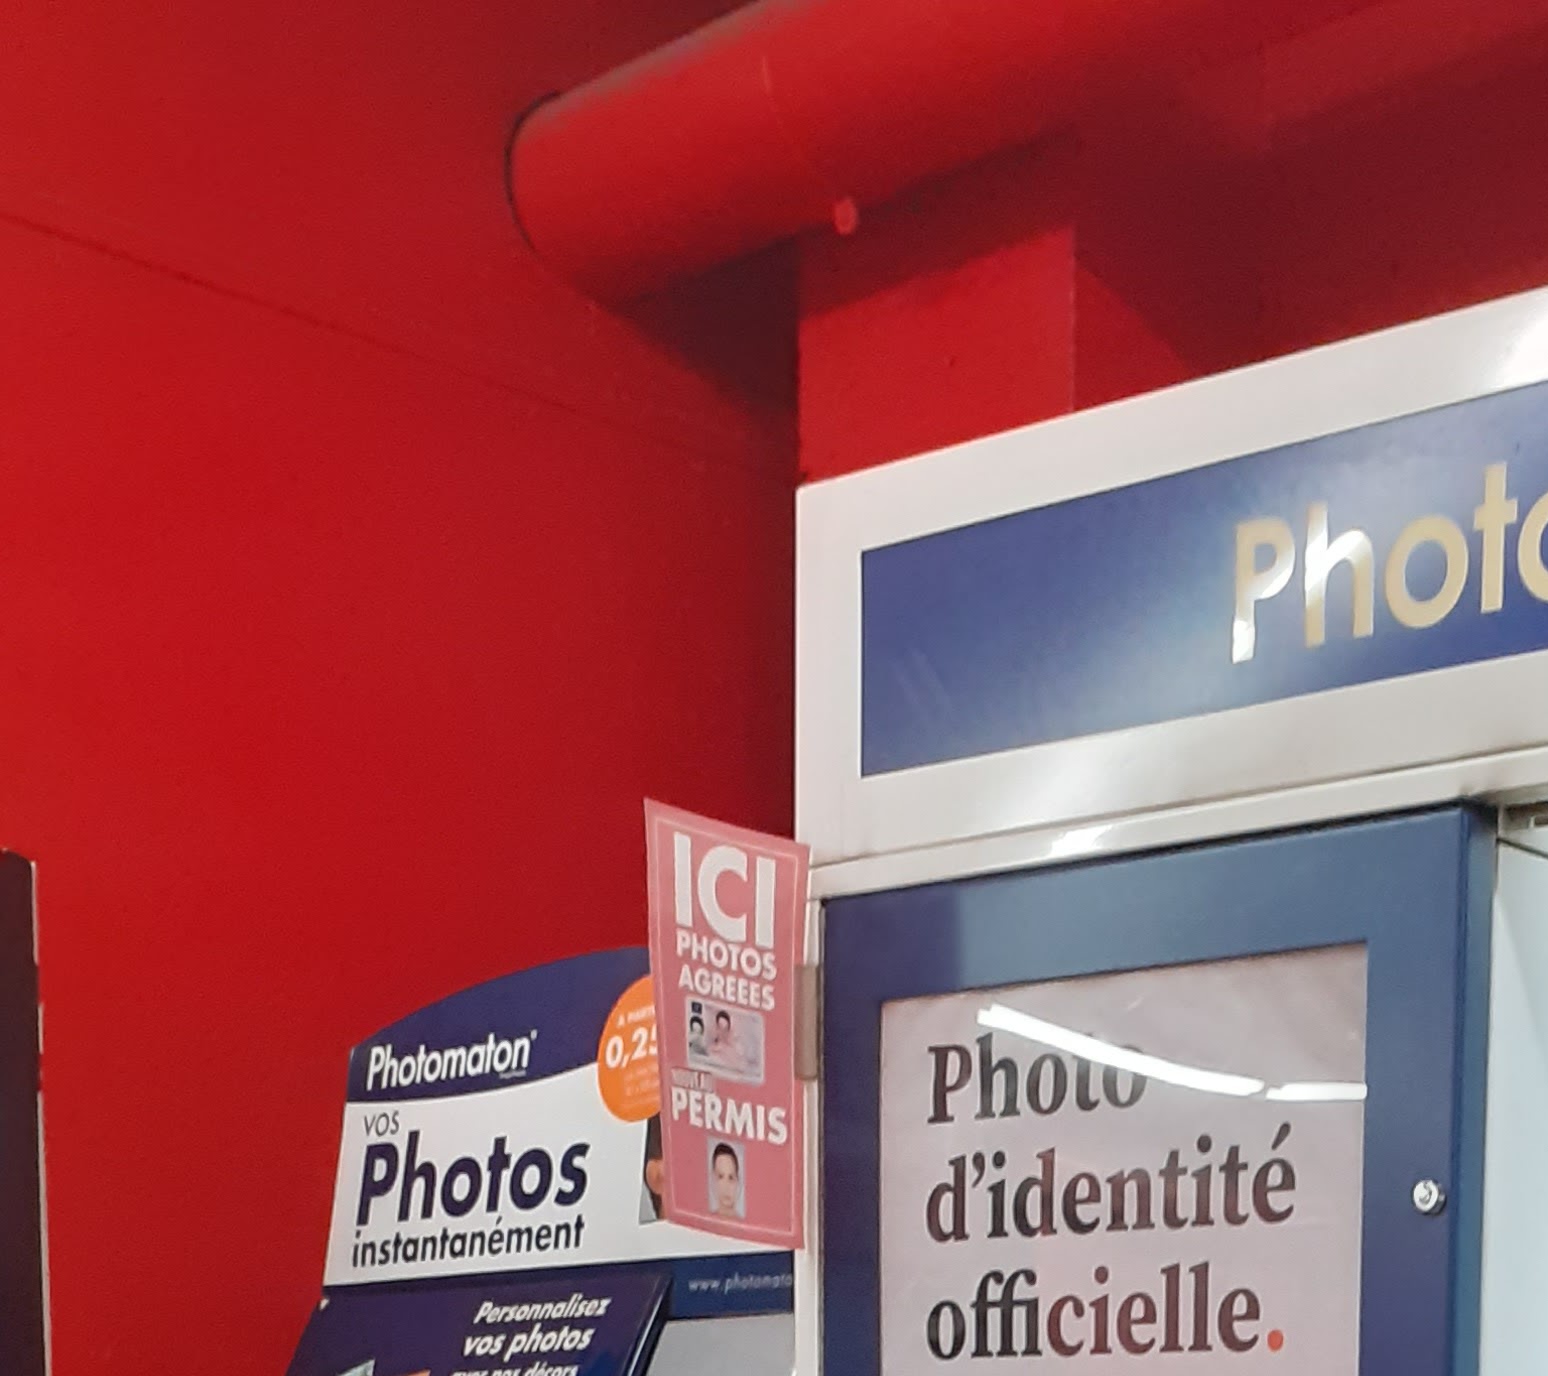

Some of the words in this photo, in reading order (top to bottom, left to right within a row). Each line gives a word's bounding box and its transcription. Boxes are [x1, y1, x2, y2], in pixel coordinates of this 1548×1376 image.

[673, 831, 777, 949] ICI
[676, 929, 778, 981] PHOTOS
[671, 1087, 788, 1146] PERMIS
[356, 1130, 591, 1227] Photos
[925, 1122, 1296, 1243] d'identité
[352, 1214, 585, 1268] instantanément
[473, 1292, 613, 1325] Personnalisez
[926, 1260, 1285, 1361] officielle.
[463, 1334, 508, 1358] vos
[502, 1323, 596, 1363] photos
